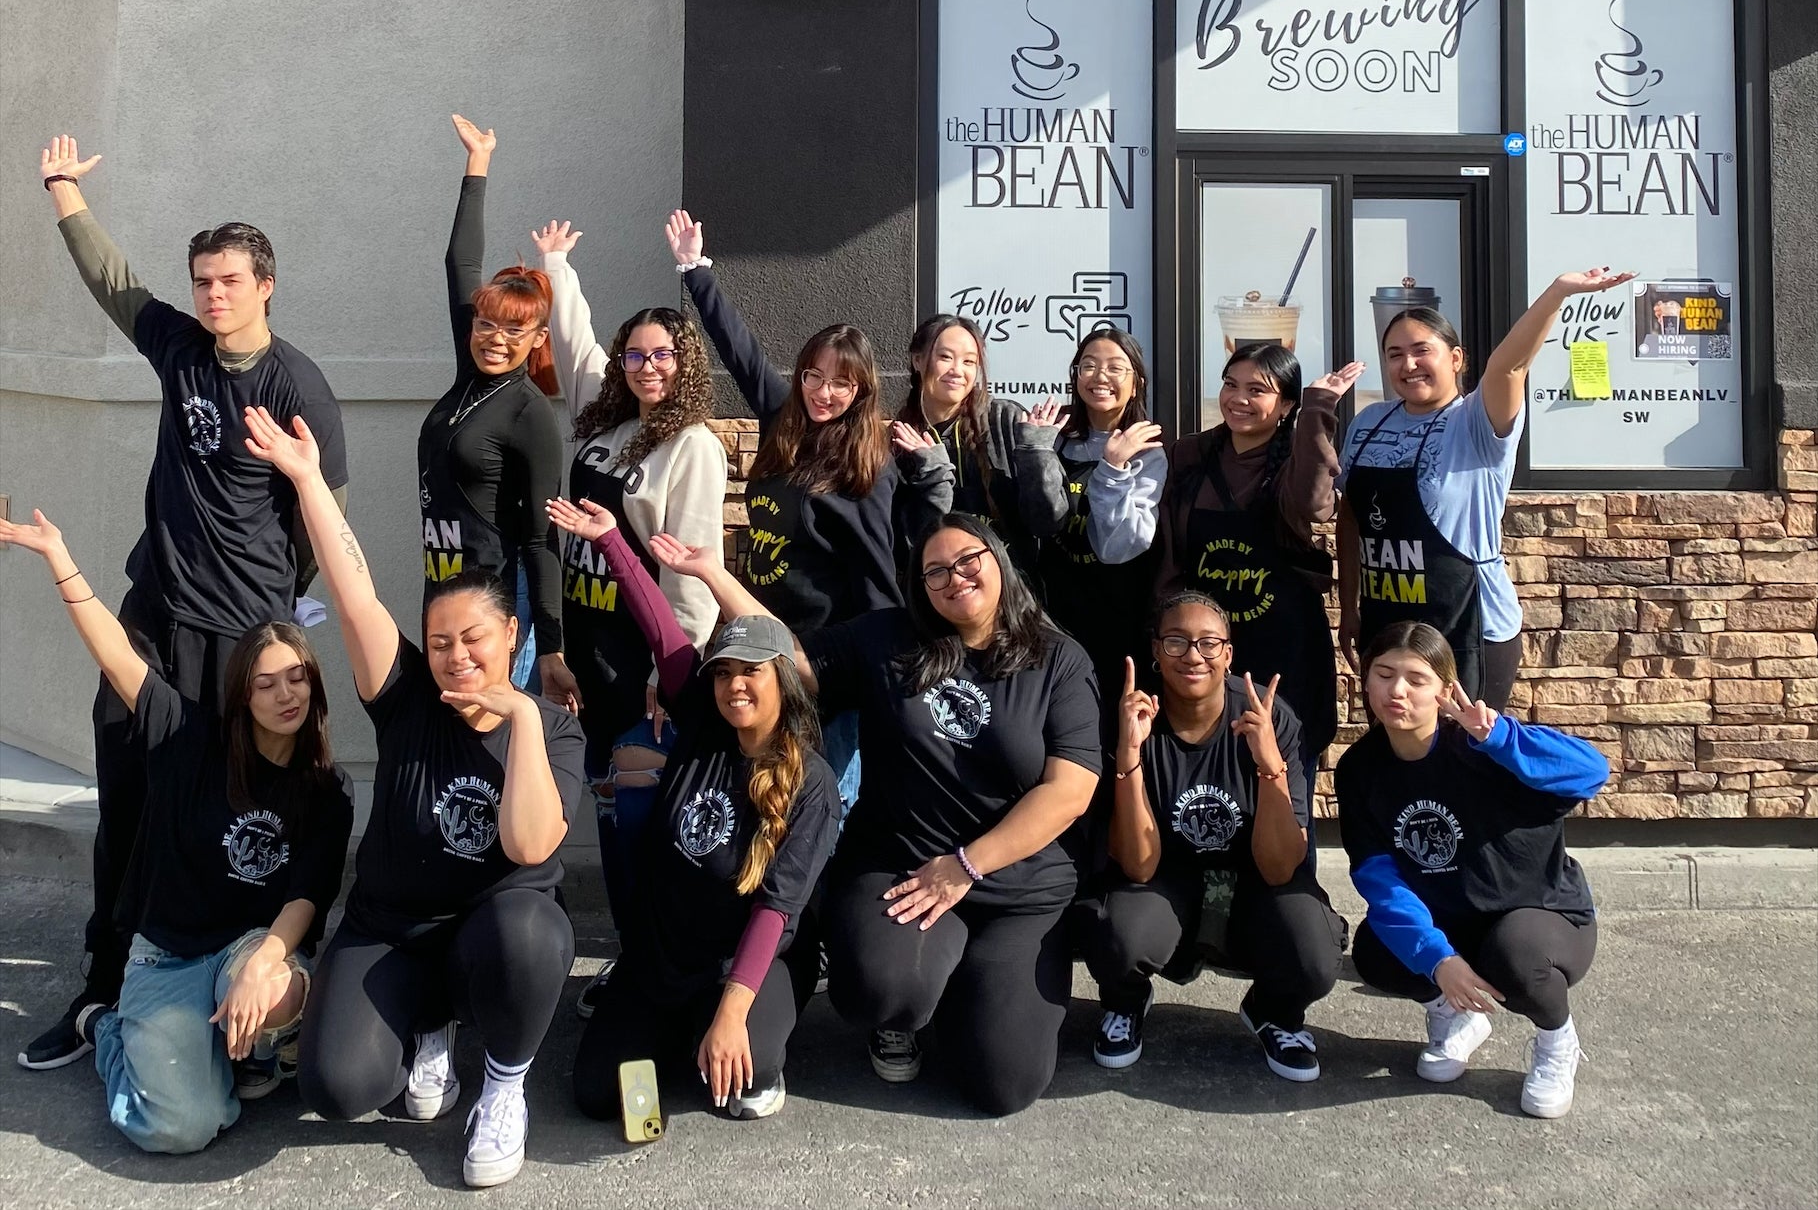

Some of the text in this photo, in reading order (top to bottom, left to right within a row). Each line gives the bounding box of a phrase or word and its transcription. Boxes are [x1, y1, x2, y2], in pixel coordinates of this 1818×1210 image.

[1267, 47, 1441, 93] SOON
[944, 106, 1119, 144] the HUMAN
[1530, 113, 1702, 150] the HUMAN
[1507, 139, 1525, 149] ADT
[950, 286, 1037, 317] Follow
[1560, 294, 1625, 325] ollow
[1684, 297, 1717, 308] KIND
[1684, 318, 1717, 331] BEAN
[1658, 335, 1686, 344] NOW
[1658, 345, 1697, 355] HIRING
[1622, 411, 1650, 424] SW
[751, 495, 781, 516] MADE BY
[1206, 538, 1254, 556] MADE BY
[760, 559, 790, 586] BEANS
[1197, 551, 1272, 596] happy
[1243, 592, 1275, 622] BEANS
[960, 679, 989, 701] HUMAN
[470, 776, 501, 802] HUMAN
[1175, 788, 1196, 808] KIND
[236, 810, 260, 826] KIND
[1396, 803, 1415, 824] KIND
[1416, 799, 1450, 815] HUMAN
[1447, 813, 1465, 840] BEAN
